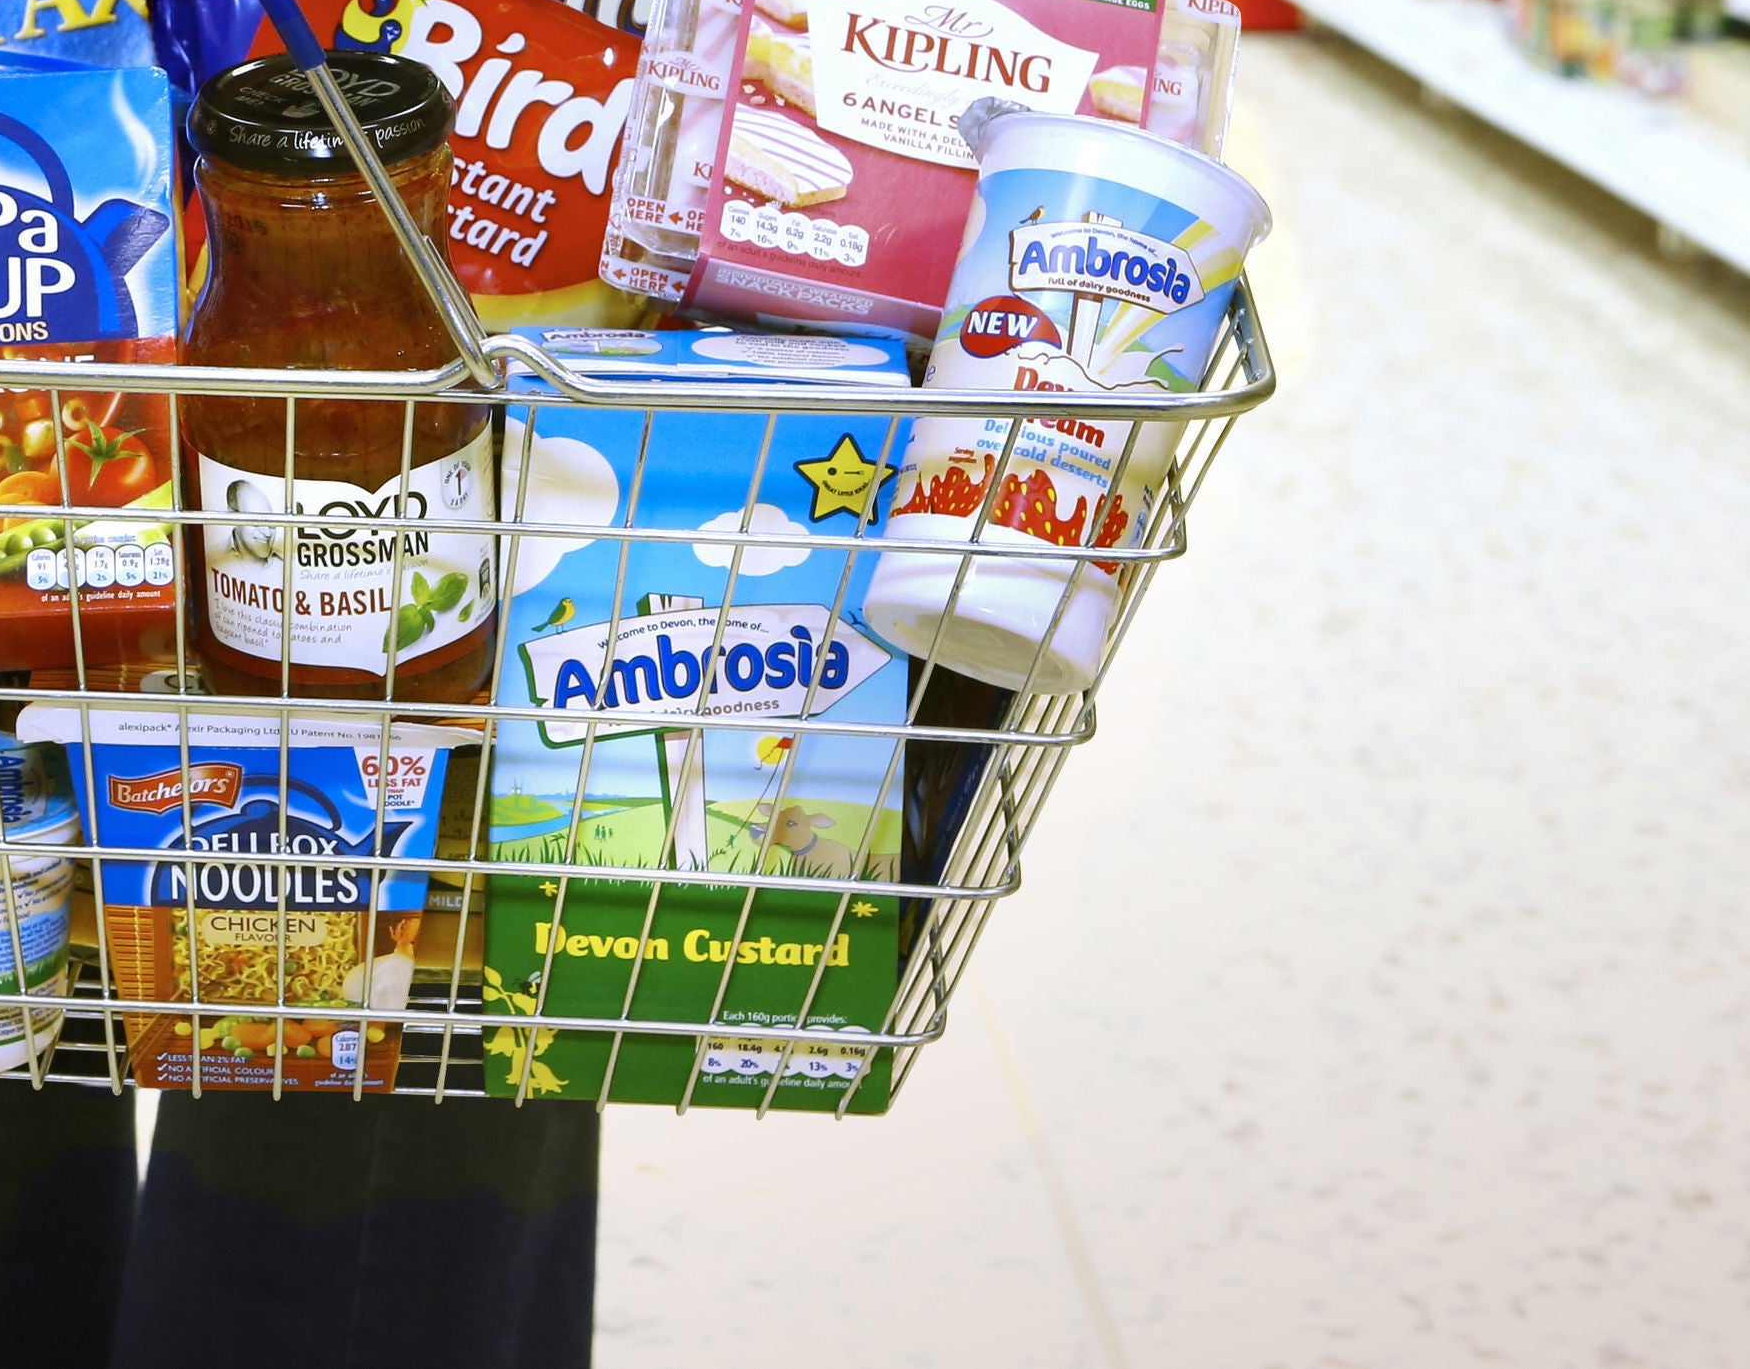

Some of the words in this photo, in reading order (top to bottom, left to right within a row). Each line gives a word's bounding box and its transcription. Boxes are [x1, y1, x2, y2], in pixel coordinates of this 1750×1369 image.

[1126, 0, 1151, 10] EGGS
[841, 11, 1053, 93] KIPLING
[648, 59, 721, 91] KIPLING
[842, 92, 858, 107] 6
[861, 96, 942, 127] ANGEL
[229, 124, 272, 147] Share
[277, 137, 288, 149] a
[375, 116, 427, 148] passion
[861, 117, 893, 132] MADE
[898, 125, 927, 140] WITH
[930, 132, 938, 142] A
[883, 133, 933, 151] VANILLA
[626, 197, 666, 212] OPEN
[625, 209, 664, 225] HERE
[730, 215, 746, 225] 140
[755, 220, 778, 233] 14.3g
[785, 226, 804, 239] 6.2g
[813, 233, 832, 246] 2.2g
[840, 238, 863, 253] 0.18g
[756, 234, 773, 245] 16%
[813, 246, 830, 258] 11%
[630, 267, 668, 282] OPEN
[1018, 236, 1192, 305] Ambrosia
[629, 278, 667, 293] HERE
[1067, 278, 1078, 286] of
[1079, 279, 1104, 293] dairy
[1106, 286, 1152, 303] goodness
[966, 310, 1040, 340] NEW
[1013, 445, 1048, 464] cold
[1050, 452, 1110, 489] desserts
[1059, 441, 1112, 471] poured
[297, 531, 430, 568] GROSSMAN
[211, 567, 284, 613] TOMATO
[295, 590, 312, 616] &
[319, 587, 392, 617] BASIL
[647, 621, 659, 632] to
[660, 617, 696, 631] Devon,
[698, 617, 716, 627] the
[320, 634, 342, 644] and
[553, 624, 849, 711] Ambrosia
[703, 698, 780, 717] goodness
[207, 725, 260, 737] Packaging
[263, 727, 280, 736] Ltd
[301, 729, 334, 738] Patent
[361, 755, 426, 776] 60%
[117, 776, 230, 804] Batcheors
[401, 777, 423, 788] FAT
[170, 862, 359, 904] NOODLES
[210, 915, 316, 933] CHICKEN
[235, 932, 292, 943] FLAVOUR
[535, 922, 669, 961] Devon
[683, 929, 850, 967] Custard
[723, 1010, 745, 1021] Each
[748, 1011, 770, 1023] 160g
[231, 1056, 247, 1064] FAT
[707, 1042, 724, 1051] 160
[738, 1043, 763, 1054] 18.4g
[809, 1046, 828, 1056] 2.6g
[840, 1047, 866, 1057] 0.16g
[809, 1061, 828, 1072] 13%
